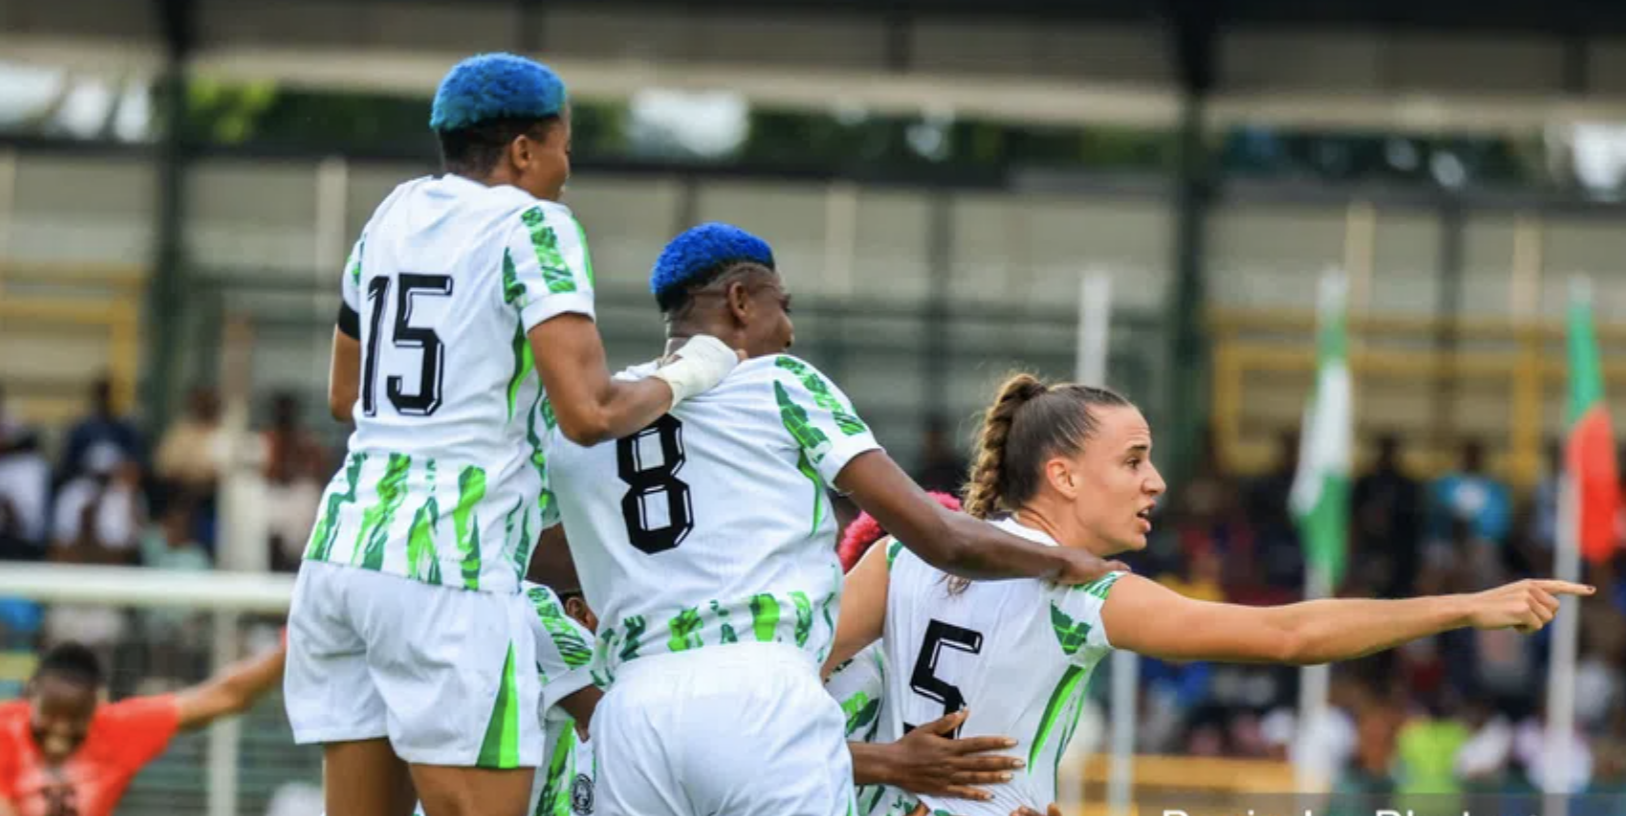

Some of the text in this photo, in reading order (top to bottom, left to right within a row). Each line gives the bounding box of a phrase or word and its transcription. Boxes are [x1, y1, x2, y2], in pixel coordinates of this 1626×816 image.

[362, 272, 454, 417] 15
[616, 412, 694, 555] 8
[902, 618, 984, 740] 5
